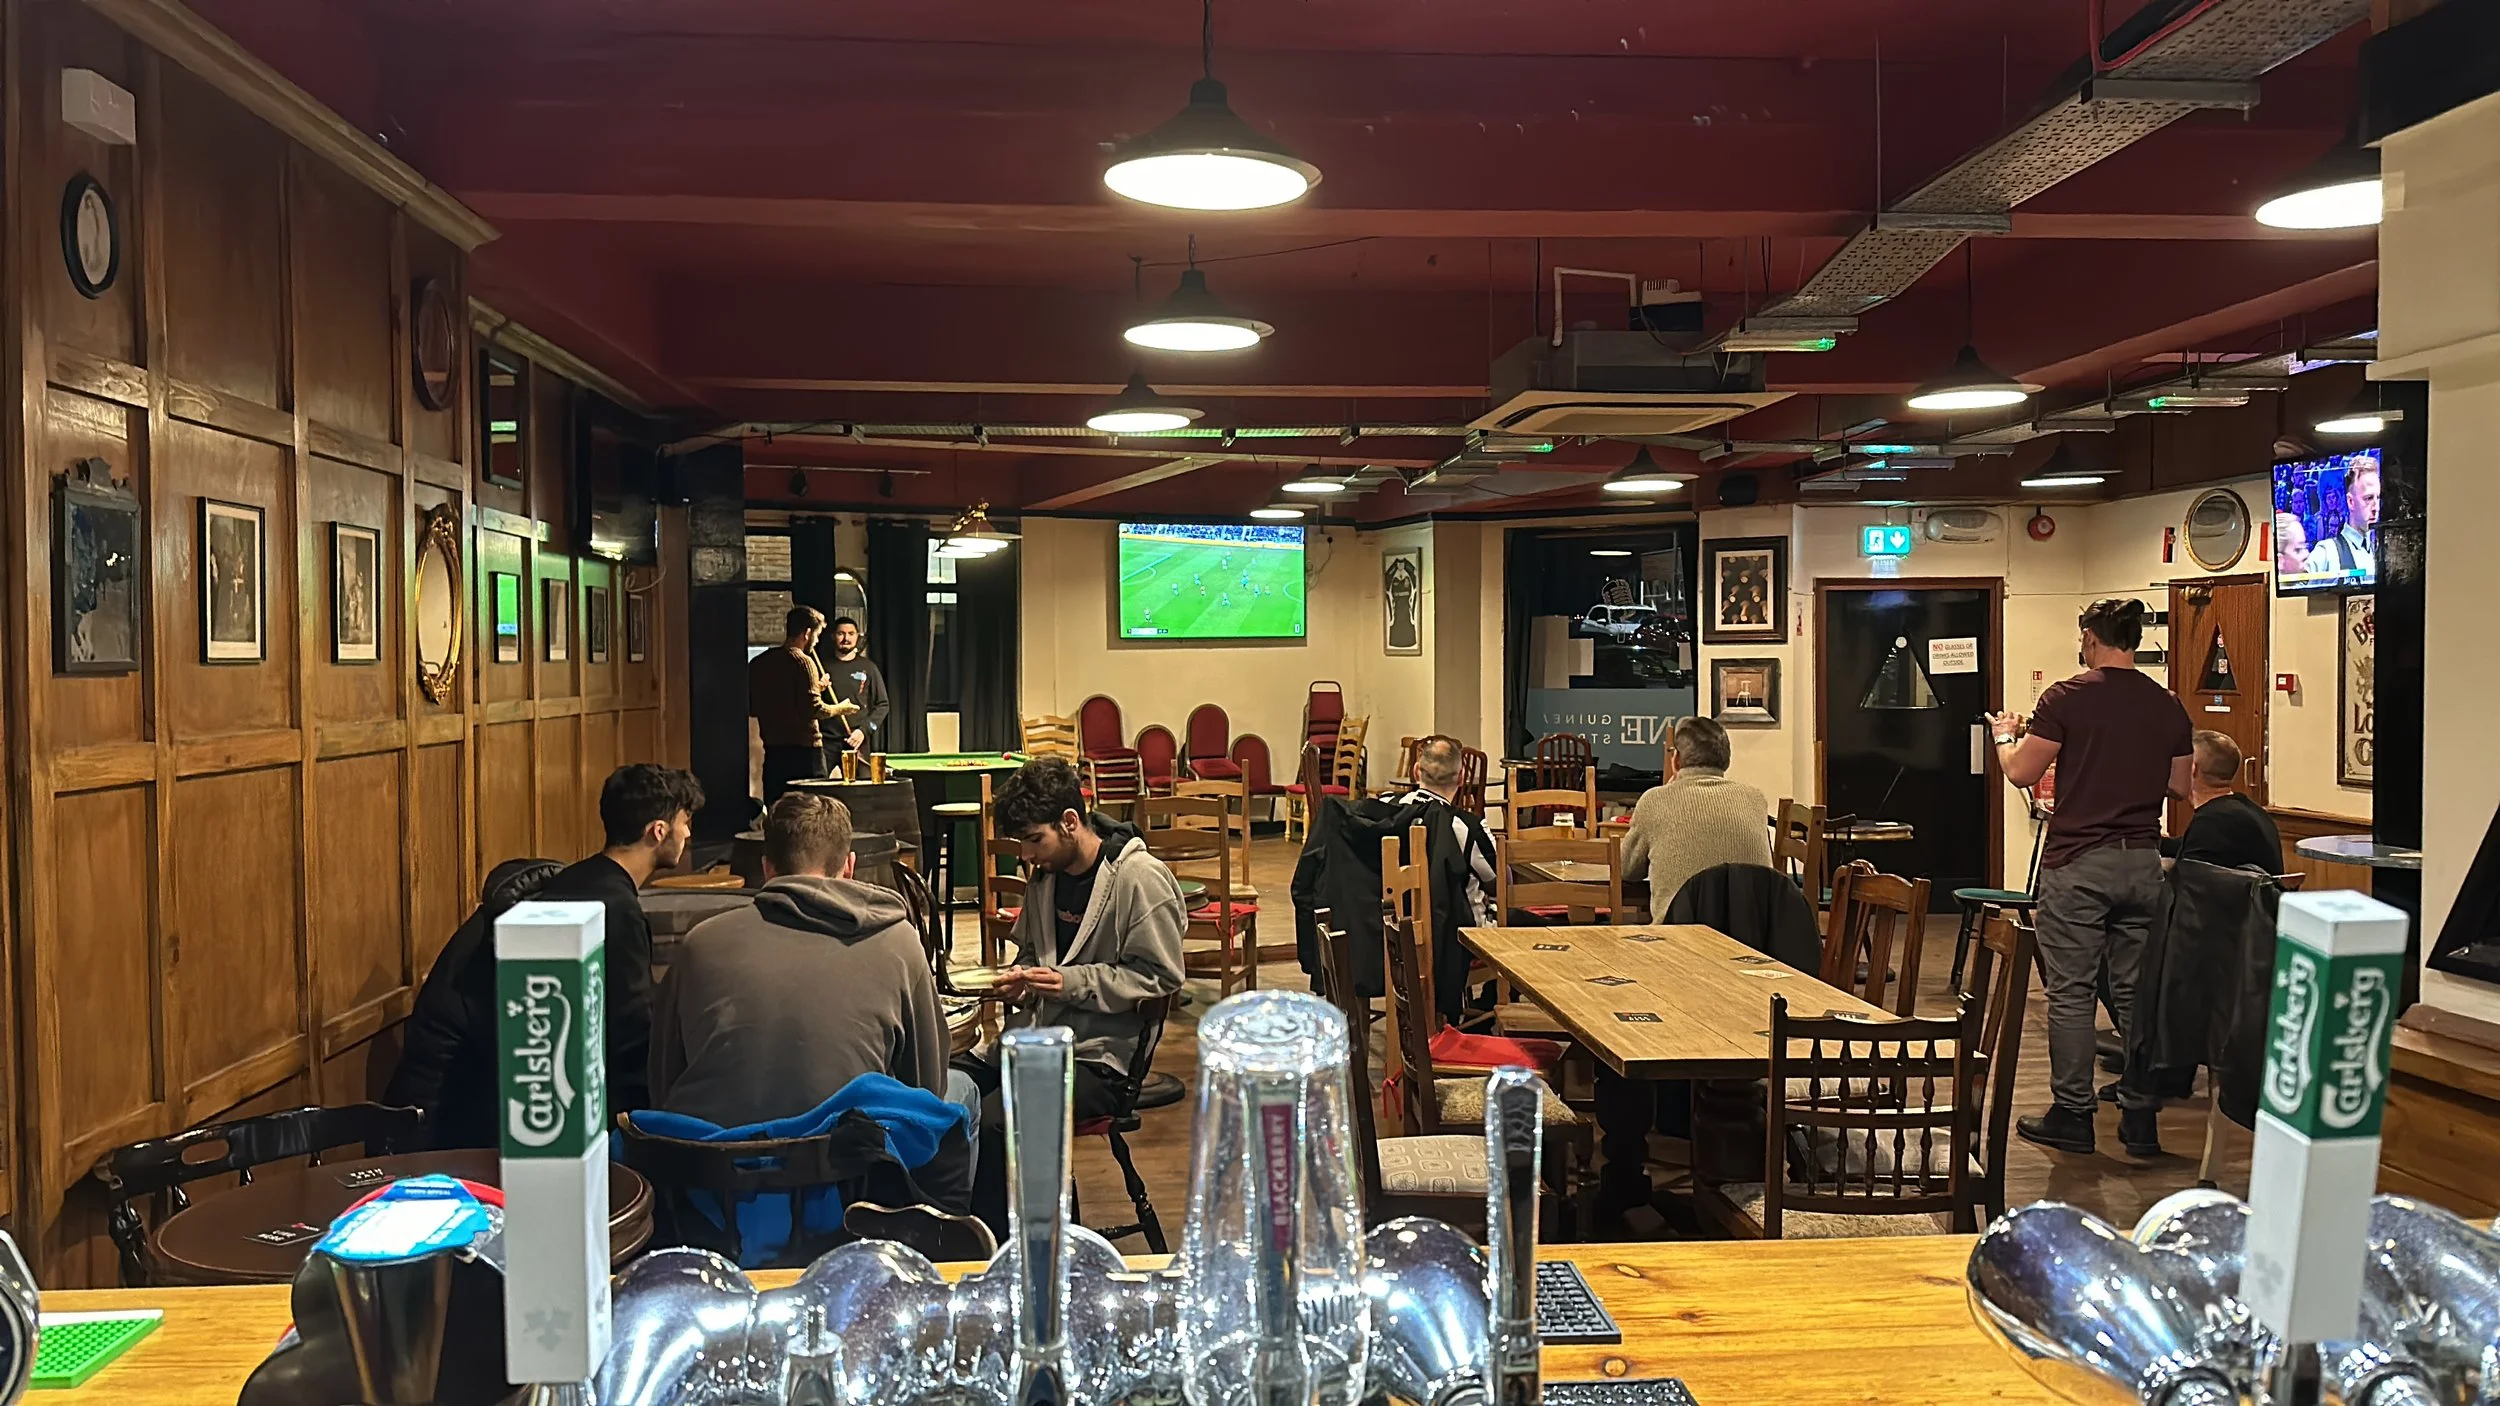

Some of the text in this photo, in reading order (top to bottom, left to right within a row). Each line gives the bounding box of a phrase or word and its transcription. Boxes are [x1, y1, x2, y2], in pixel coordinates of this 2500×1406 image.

[508, 973, 576, 1147] Carlsberg
[2264, 953, 2319, 1115] Carlsberg
[2320, 967, 2390, 1129] Carlsberg
[1270, 1114, 1289, 1226] BLACKBERRY
